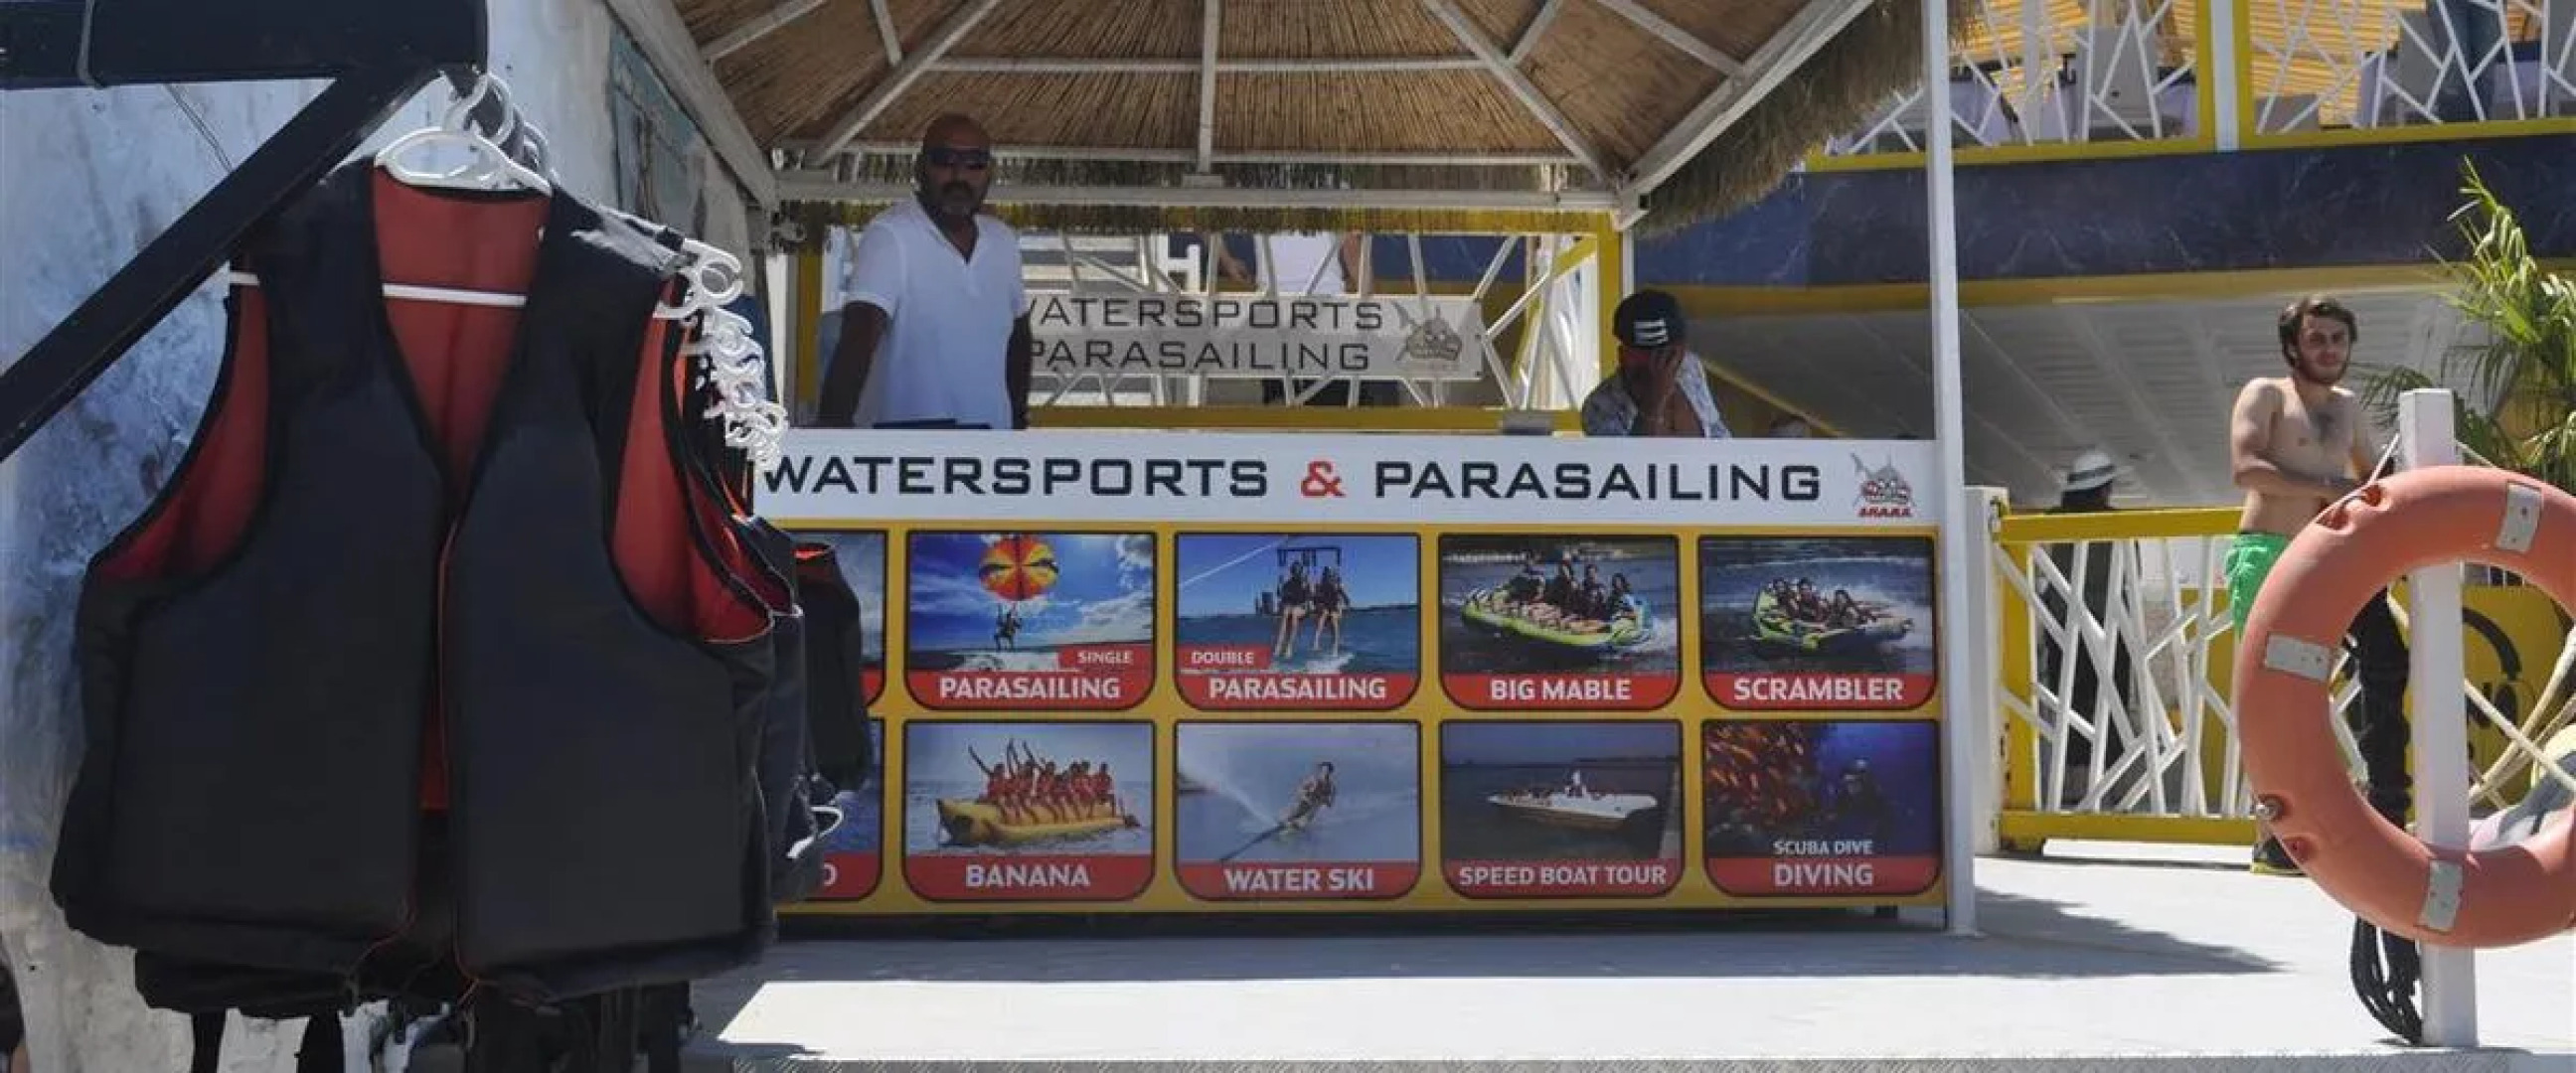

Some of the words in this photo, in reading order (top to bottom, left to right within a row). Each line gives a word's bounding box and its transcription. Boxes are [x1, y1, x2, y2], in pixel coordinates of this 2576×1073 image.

[1030, 297, 1382, 327] ATERSPORTS
[763, 456, 1267, 497] WATERSPORTS
[1301, 458, 1345, 499] &
[1375, 461, 1821, 501] PARASAILING
[1077, 650, 1133, 665] SINGLE
[1192, 651, 1254, 665] DOUBLE
[940, 678, 1120, 699] PARASAILING
[1209, 678, 1385, 700] PARASAILING
[1491, 679, 1535, 700] BIG
[1543, 679, 1631, 700] MABLE
[1734, 677, 1902, 700] SCRAMBLER
[1773, 841, 1829, 854] SCUBA
[1834, 841, 1872, 854] DIVE
[966, 863, 1091, 887] BANANA
[1224, 868, 1323, 891] WATER
[1331, 868, 1373, 890] SKI
[1460, 865, 1532, 885] SPEED
[1539, 865, 1600, 884] BOAT
[1604, 865, 1667, 885] TOUR
[1774, 862, 1873, 887] DIVING
